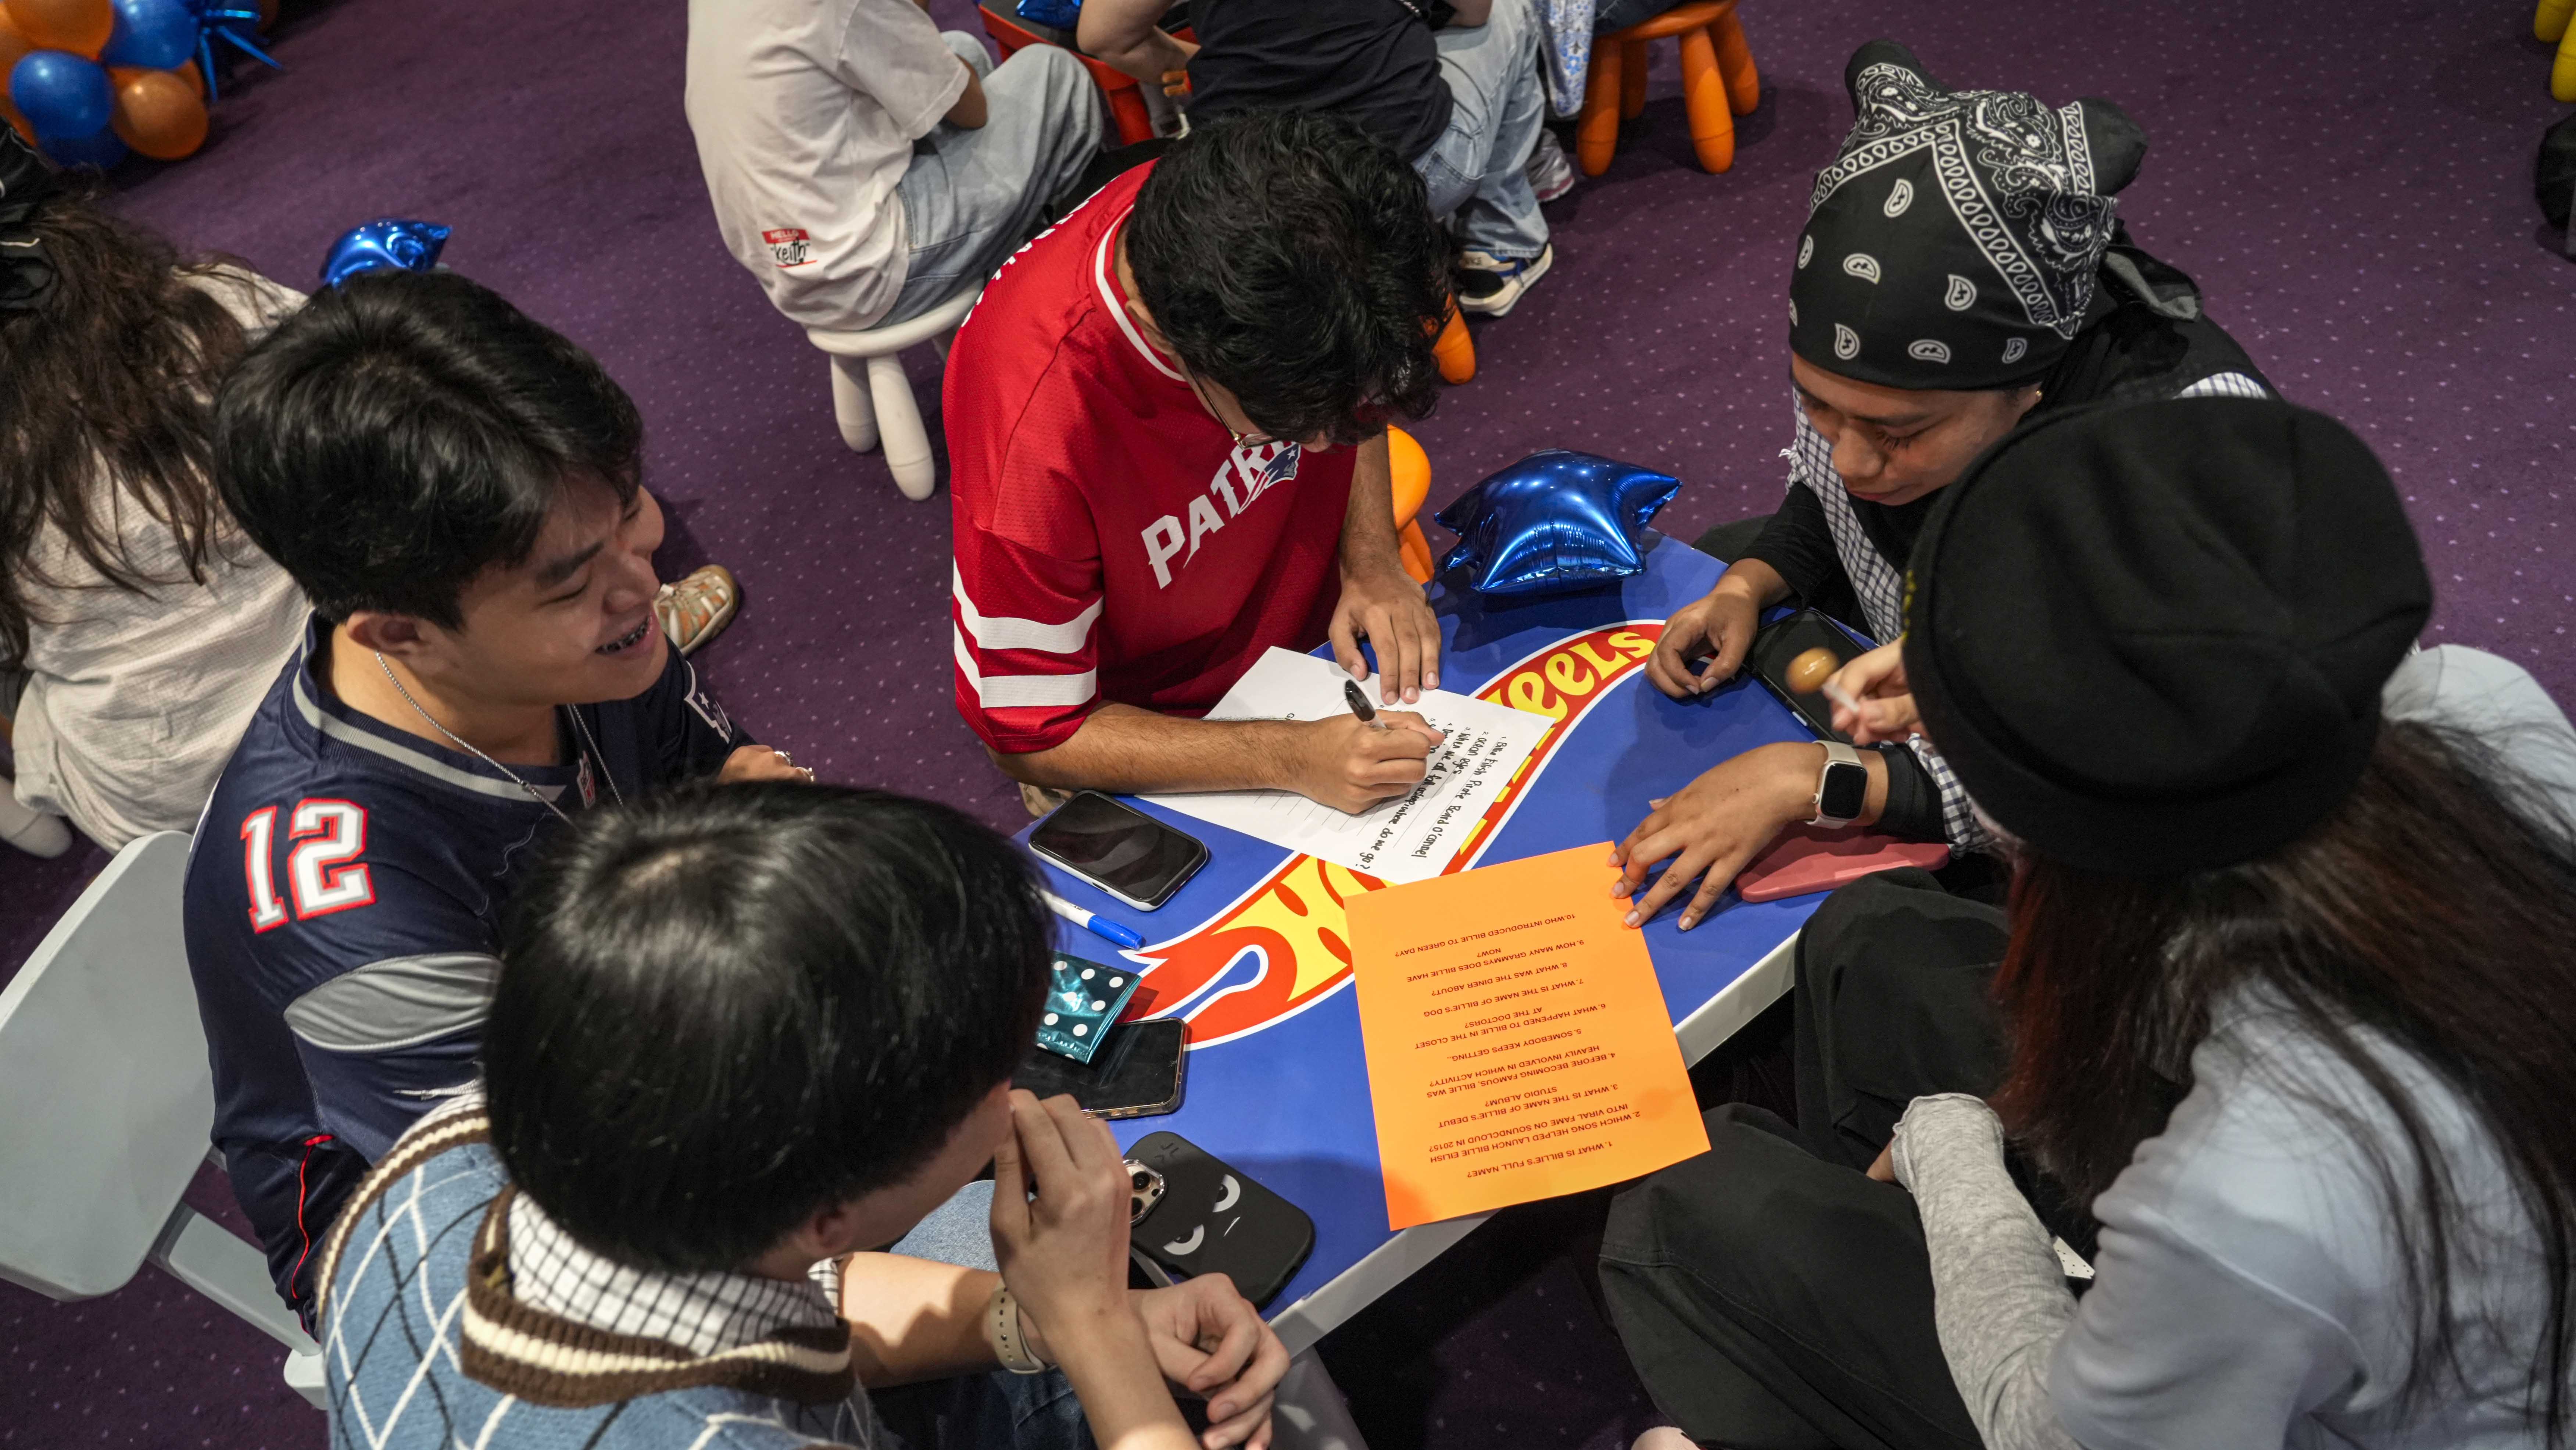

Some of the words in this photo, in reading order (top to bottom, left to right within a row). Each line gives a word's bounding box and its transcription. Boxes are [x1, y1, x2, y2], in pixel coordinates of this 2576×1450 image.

[1441, 750, 1455, 761] we
[1431, 762, 1447, 772] all
[1452, 758, 1470, 774] eyes
[1421, 774, 1442, 786] fall
[1455, 780, 1482, 799] Pirate
[1380, 828, 1393, 838] do
[1371, 839, 1385, 851] we
[240, 797, 376, 934] 12
[1355, 852, 1374, 870] go?
[1488, 920, 1542, 936] INTRODUCED
[1460, 932, 1486, 942] BILLIE
[1417, 942, 1445, 951] GREEN
[1529, 946, 1553, 956] MANY
[1556, 942, 1576, 950] HOW
[1395, 948, 1415, 957] DAY?
[1477, 948, 1501, 957] NOW?
[1483, 952, 1526, 965] GRAMMYS
[1430, 967, 1456, 976] BILLIE
[1458, 962, 1481, 971] DOES
[1535, 964, 1559, 974] WHAT
[1406, 973, 1428, 982] HAVE
[1514, 970, 1533, 978] WAS
[1467, 978, 1493, 988] DINER
[1551, 981, 1575, 990] WHAT
[1431, 984, 1464, 996] ABOUT?
[1494, 992, 1519, 1002] NAME
[1424, 1008, 1442, 1017] DOG
[1445, 1001, 1478, 1013] BILLIE'S
[1573, 1006, 1598, 1015] WHAT
[1464, 1014, 1510, 1028] DOCTORS?
[1523, 1011, 1570, 1025] HAPPENED
[1480, 1025, 1507, 1035] BILLIE
[1450, 1033, 1467, 1041] THE
[1523, 1031, 1573, 1046] SOMEBODY
[1415, 1037, 1448, 1049] CLOSET
[1492, 1042, 1520, 1053] KEEPS
[1564, 1045, 1599, 1058] HEAVILY
[1518, 1053, 1561, 1067] INVOLVED
[1570, 1054, 1607, 1067] BEFORE
[1475, 1066, 1505, 1077] WHICH
[1520, 1062, 1568, 1078] BECOMING
[1430, 1073, 1472, 1087] ACTIVITY?
[1478, 1074, 1517, 1086] FAMOUS,
[1427, 1089, 1446, 1098] WAS
[1448, 1083, 1475, 1093] BILLIE
[1524, 1086, 1557, 1098] STUDIO
[1584, 1086, 1609, 1096] WHAT
[1485, 1094, 1521, 1107] ALBUM?
[1523, 1099, 1550, 1109] NAME
[1552, 1094, 1570, 1103] THE
[1606, 1103, 1628, 1113] INTO
[1470, 1108, 1507, 1121] BILLIE'S
[1577, 1110, 1604, 1119] VIRAL
[1600, 1114, 1632, 1126] WHICH
[1438, 1116, 1468, 1128] DEBUT
[1534, 1121, 1548, 1129] ON
[1550, 1115, 1575, 1126] FAME
[1571, 1122, 1598, 1132] SONG
[1467, 1125, 1532, 1143] SOUNDCLOUD
[1532, 1128, 1568, 1141] HELPED
[1429, 1142, 1453, 1152] 2015?
[1492, 1136, 1530, 1150] LAUNCH
[1578, 1143, 1604, 1154] WHAT
[1461, 1145, 1489, 1156] BILLIE
[1430, 1151, 1459, 1163] EILISH
[1527, 1152, 1564, 1165] BILLIE'S
[1501, 1160, 1524, 1170] FULL
[1467, 1166, 1499, 1178] NAME?
